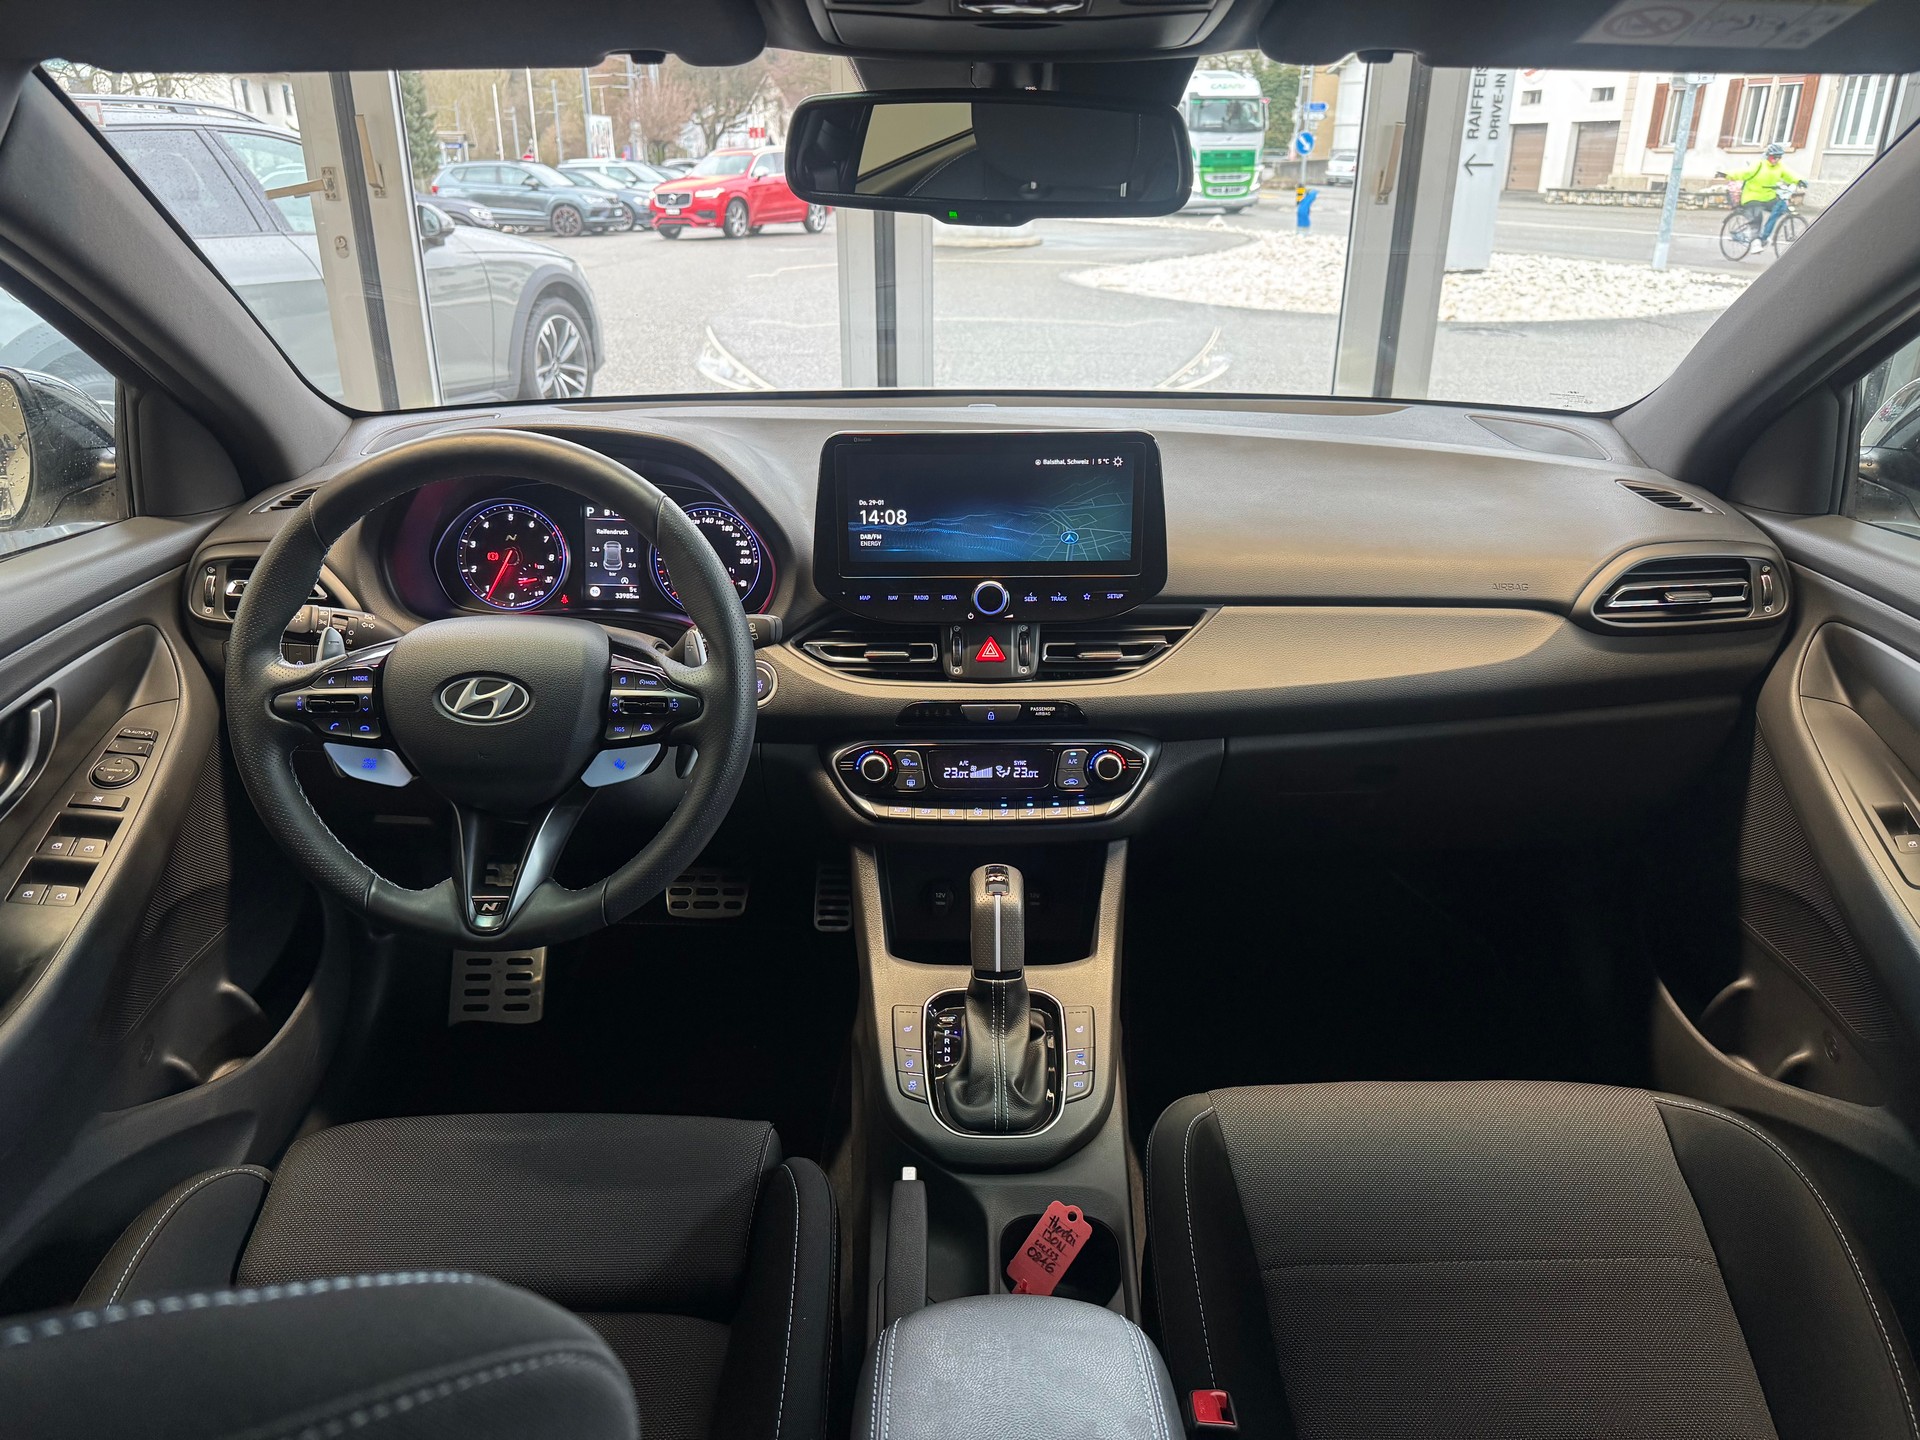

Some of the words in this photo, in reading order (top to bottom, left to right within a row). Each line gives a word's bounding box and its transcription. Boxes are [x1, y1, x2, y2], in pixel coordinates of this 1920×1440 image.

[1488, 73, 1507, 140] DRIVE-IN
[586, 507, 595, 517] P
[508, 513, 514, 521] 5
[860, 509, 907, 525] 14:08
[483, 521, 490, 529] 4
[543, 535, 549, 543] 7
[469, 540, 476, 548] 3
[548, 553, 555, 561] 8
[470, 565, 477, 573] 2
[1492, 583, 1529, 591] AIRBAG
[481, 902, 499, 911] N
